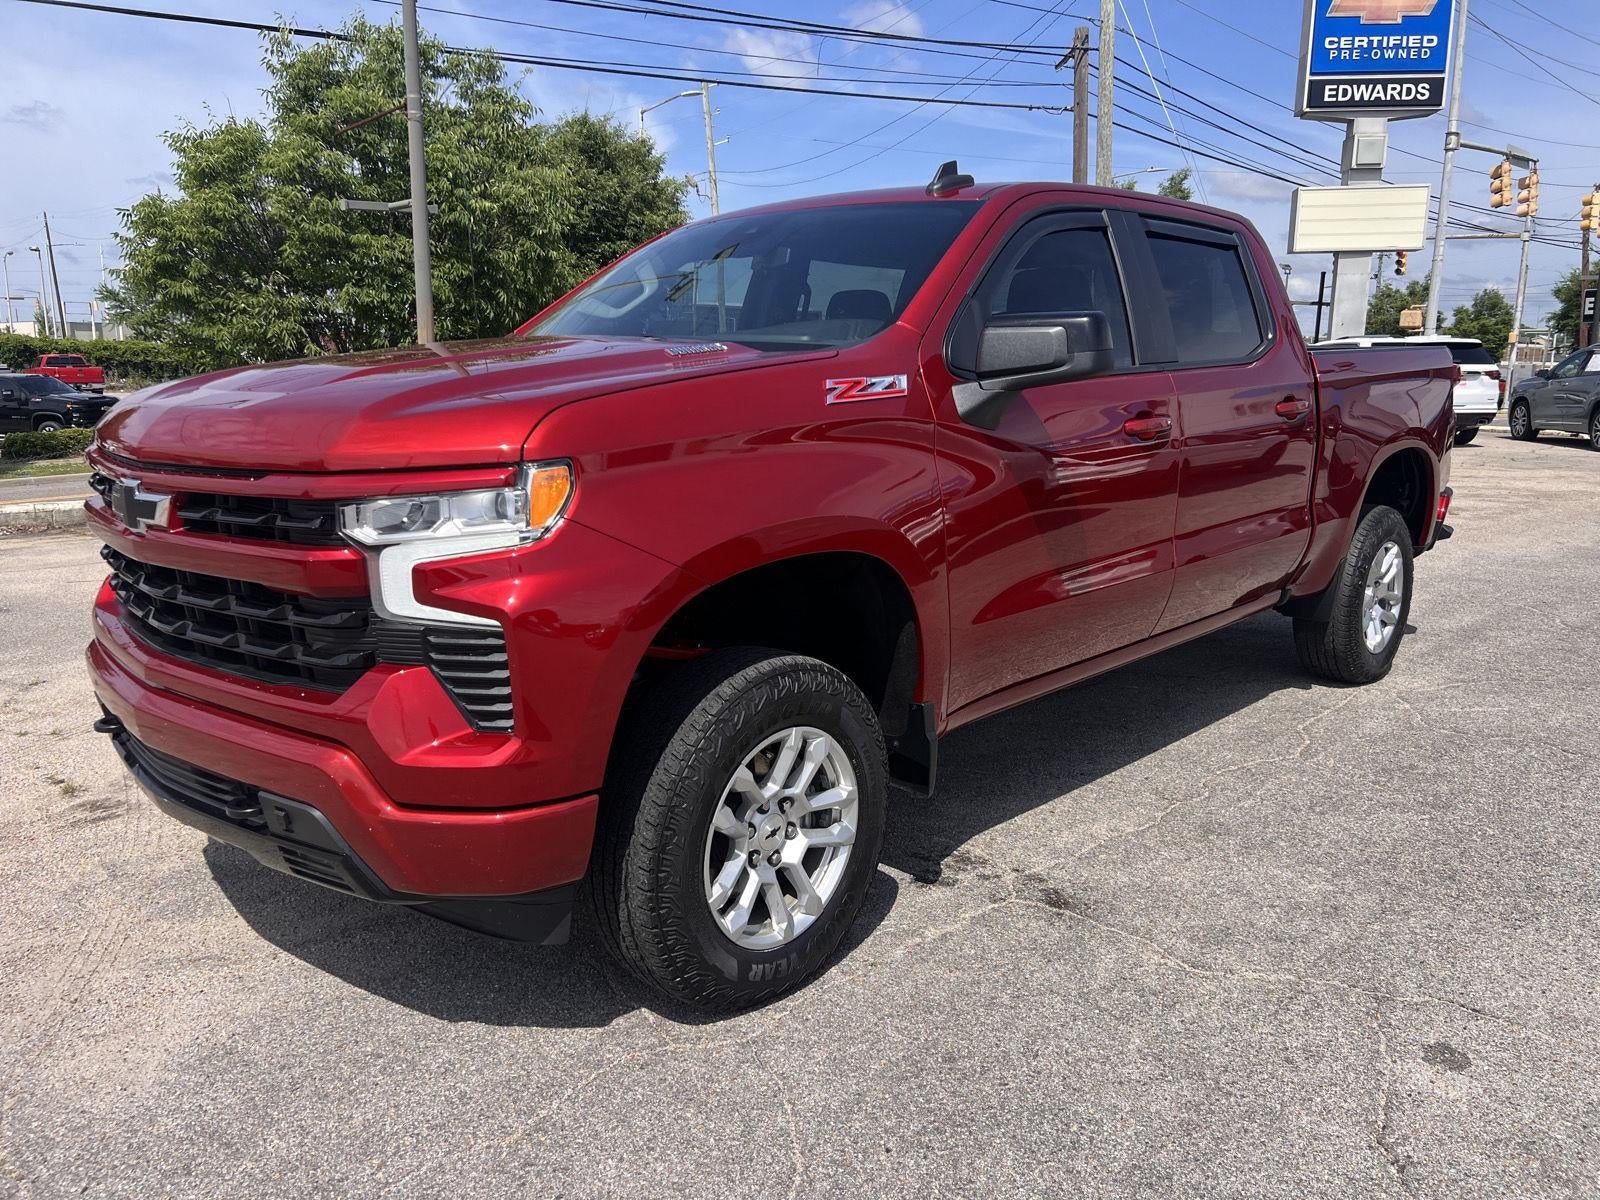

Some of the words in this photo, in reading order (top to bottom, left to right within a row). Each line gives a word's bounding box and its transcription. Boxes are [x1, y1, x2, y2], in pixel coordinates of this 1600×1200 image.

[1324, 35, 1437, 49] CERTIFIED
[1329, 49, 1430, 60] PRE-OWNED
[1323, 83, 1430, 102] EDWARDS
[826, 374, 907, 404] Z71
